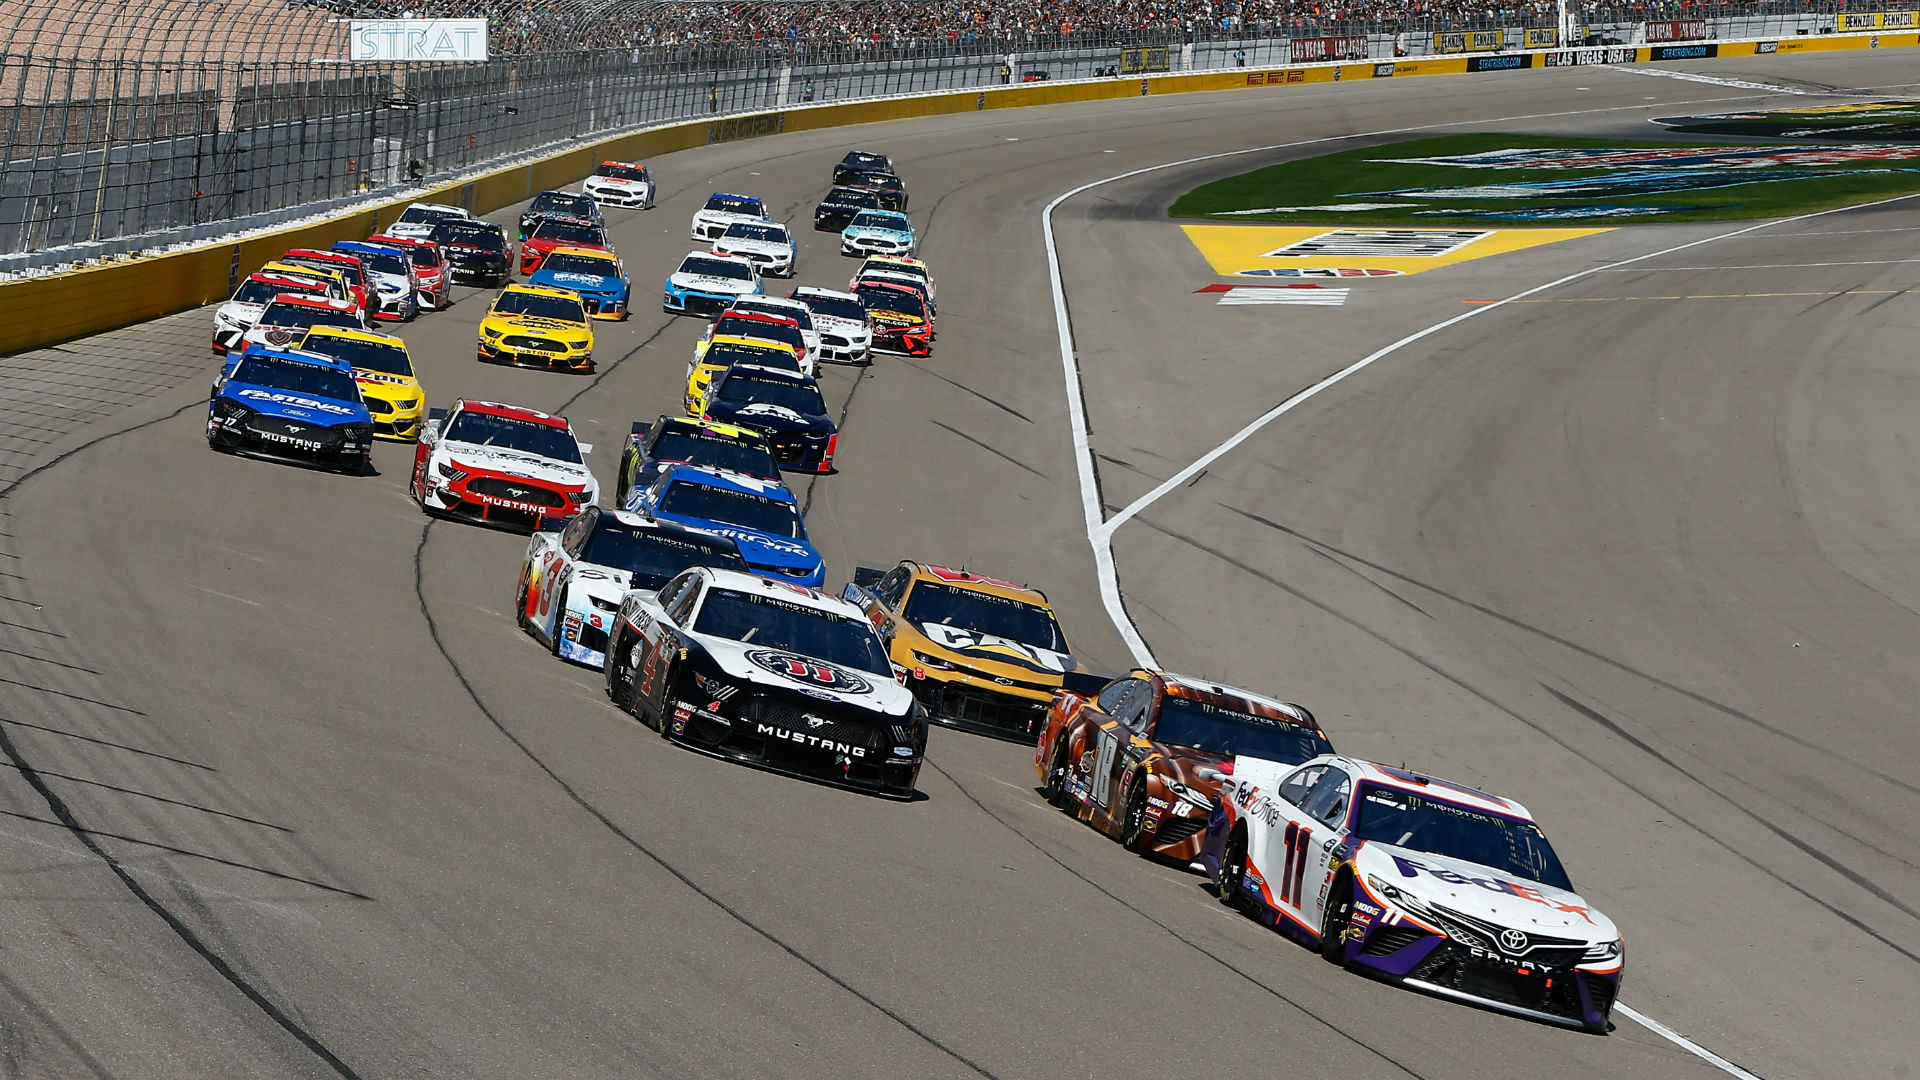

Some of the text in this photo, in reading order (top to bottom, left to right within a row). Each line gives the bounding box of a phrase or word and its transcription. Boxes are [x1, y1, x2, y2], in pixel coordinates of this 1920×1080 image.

[1845, 15, 1876, 28] PENNZOIL
[1884, 13, 1913, 26] PENNZOIL
[360, 28, 479, 58] STRAT
[1557, 52, 1573, 66] LAS
[238, 389, 357, 415] FASTENAL
[224, 416, 237, 426] 17
[260, 432, 322, 450] MUSTANG
[482, 495, 547, 514] MUSTANG
[962, 589, 1010, 605] MONSTER
[766, 598, 823, 617] MONSTER
[589, 613, 603, 628] 3
[921, 622, 1065, 673] CAT
[641, 640, 664, 697] 4
[913, 666, 926, 680] 8
[677, 701, 697, 713] MOOG
[707, 701, 720, 713] 4
[1219, 708, 1276, 726] MONSTER
[757, 723, 866, 758] MUSTANG
[1147, 796, 1169, 809] MOOG
[1171, 801, 1194, 817] 18
[1235, 780, 1280, 828] FedEx Office
[1425, 801, 1489, 822] MONSTER
[1280, 820, 1314, 912] 11
[1391, 855, 1599, 927] FedEx
[1353, 901, 1380, 916] MOOG
[1380, 907, 1404, 926] 11
[1470, 947, 1553, 974] CAMRY
